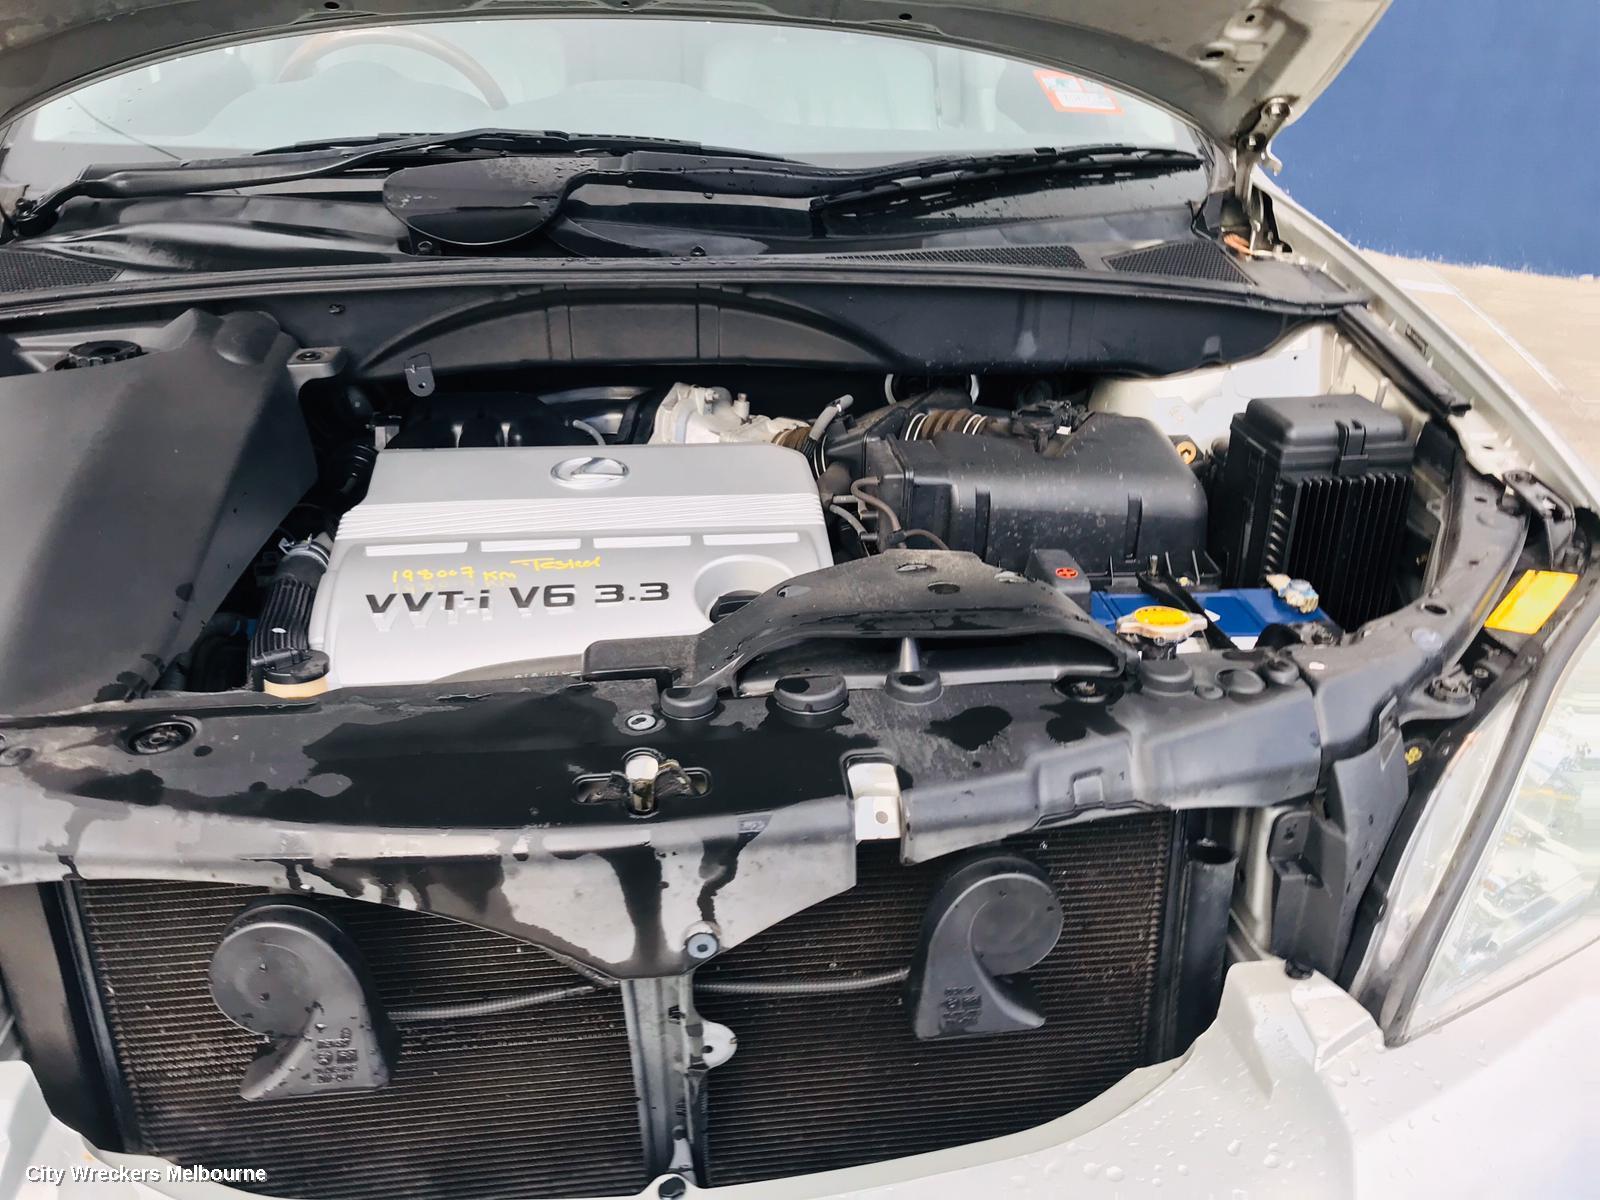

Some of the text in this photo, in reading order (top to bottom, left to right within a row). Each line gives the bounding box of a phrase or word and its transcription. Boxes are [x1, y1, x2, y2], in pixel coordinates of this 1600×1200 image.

[365, 582, 670, 614] VVT-i V6 3.3
